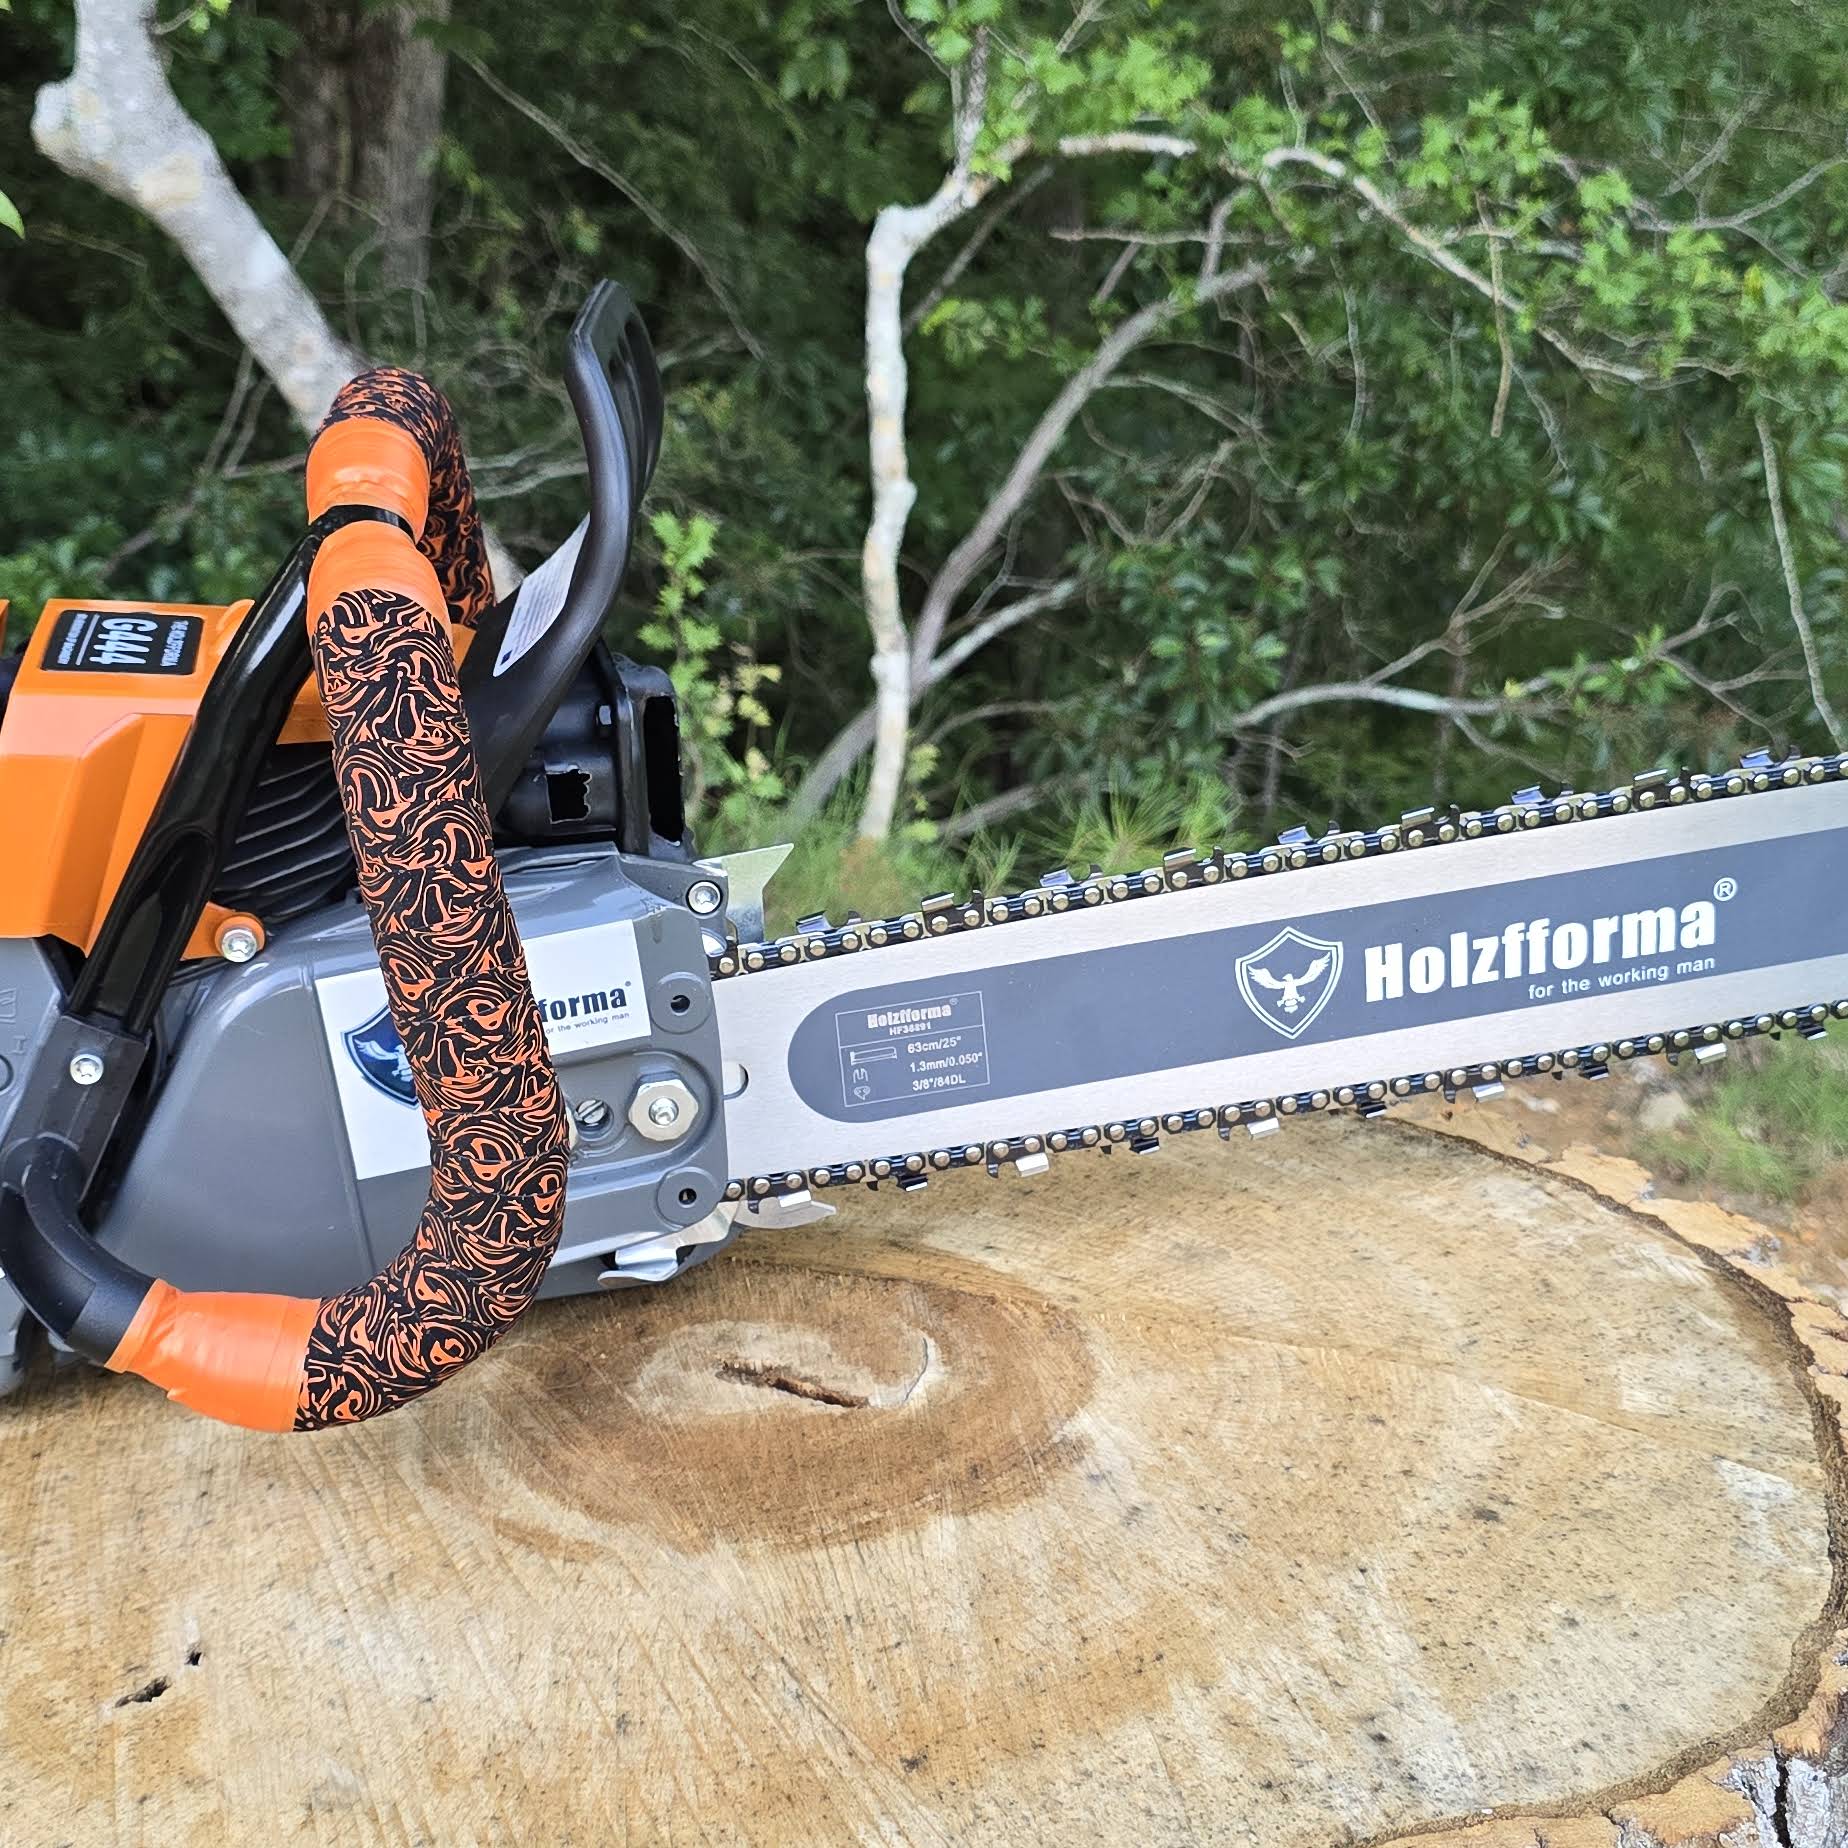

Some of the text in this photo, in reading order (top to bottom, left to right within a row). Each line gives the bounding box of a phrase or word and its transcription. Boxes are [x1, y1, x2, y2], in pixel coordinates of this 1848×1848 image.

[89, 617, 158, 664] G444
[1528, 957, 1715, 1000] for the working man
[537, 987, 627, 1022] forma
[545, 1012, 630, 1035] or the working man
